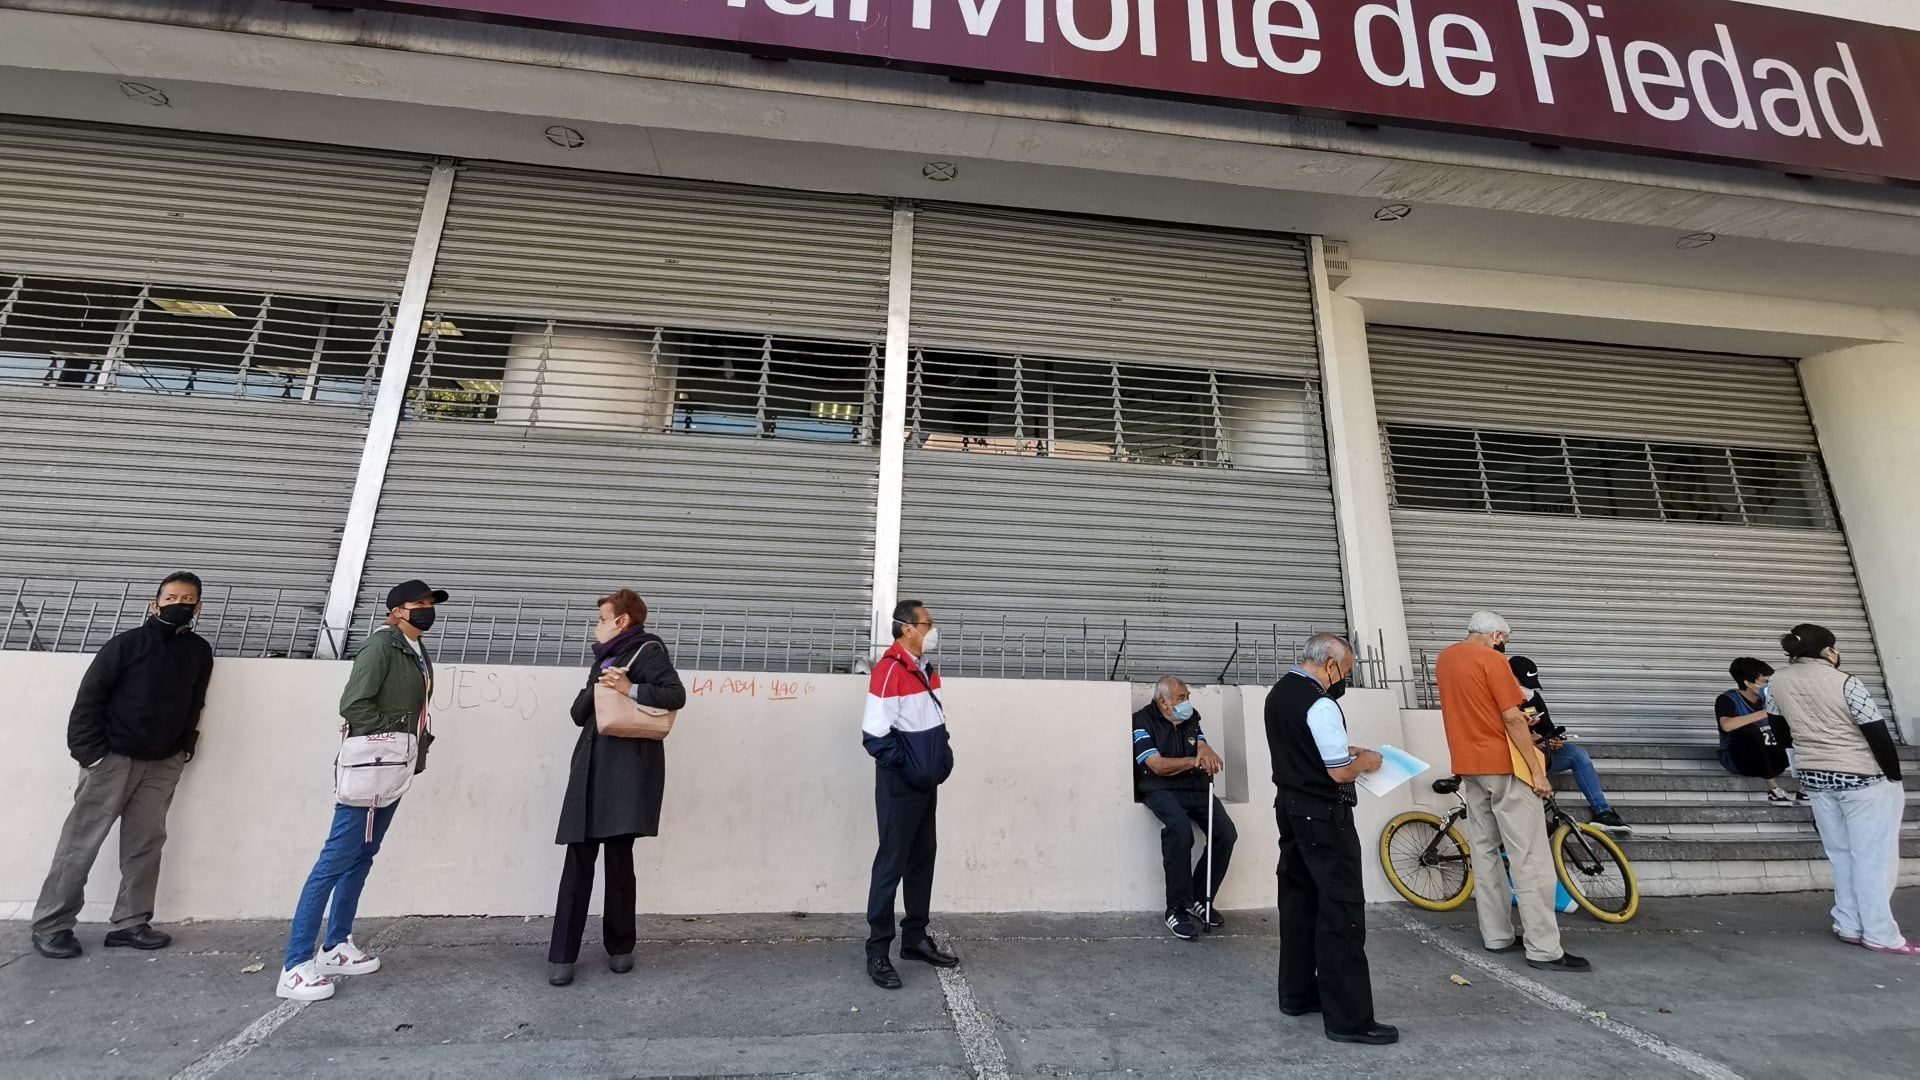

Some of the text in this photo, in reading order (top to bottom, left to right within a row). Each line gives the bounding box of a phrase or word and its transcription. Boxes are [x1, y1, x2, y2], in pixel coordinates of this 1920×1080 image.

[1353, 0, 1497, 96] de
[1518, 0, 1883, 148] Piedad
[692, 676, 713, 696] LA
